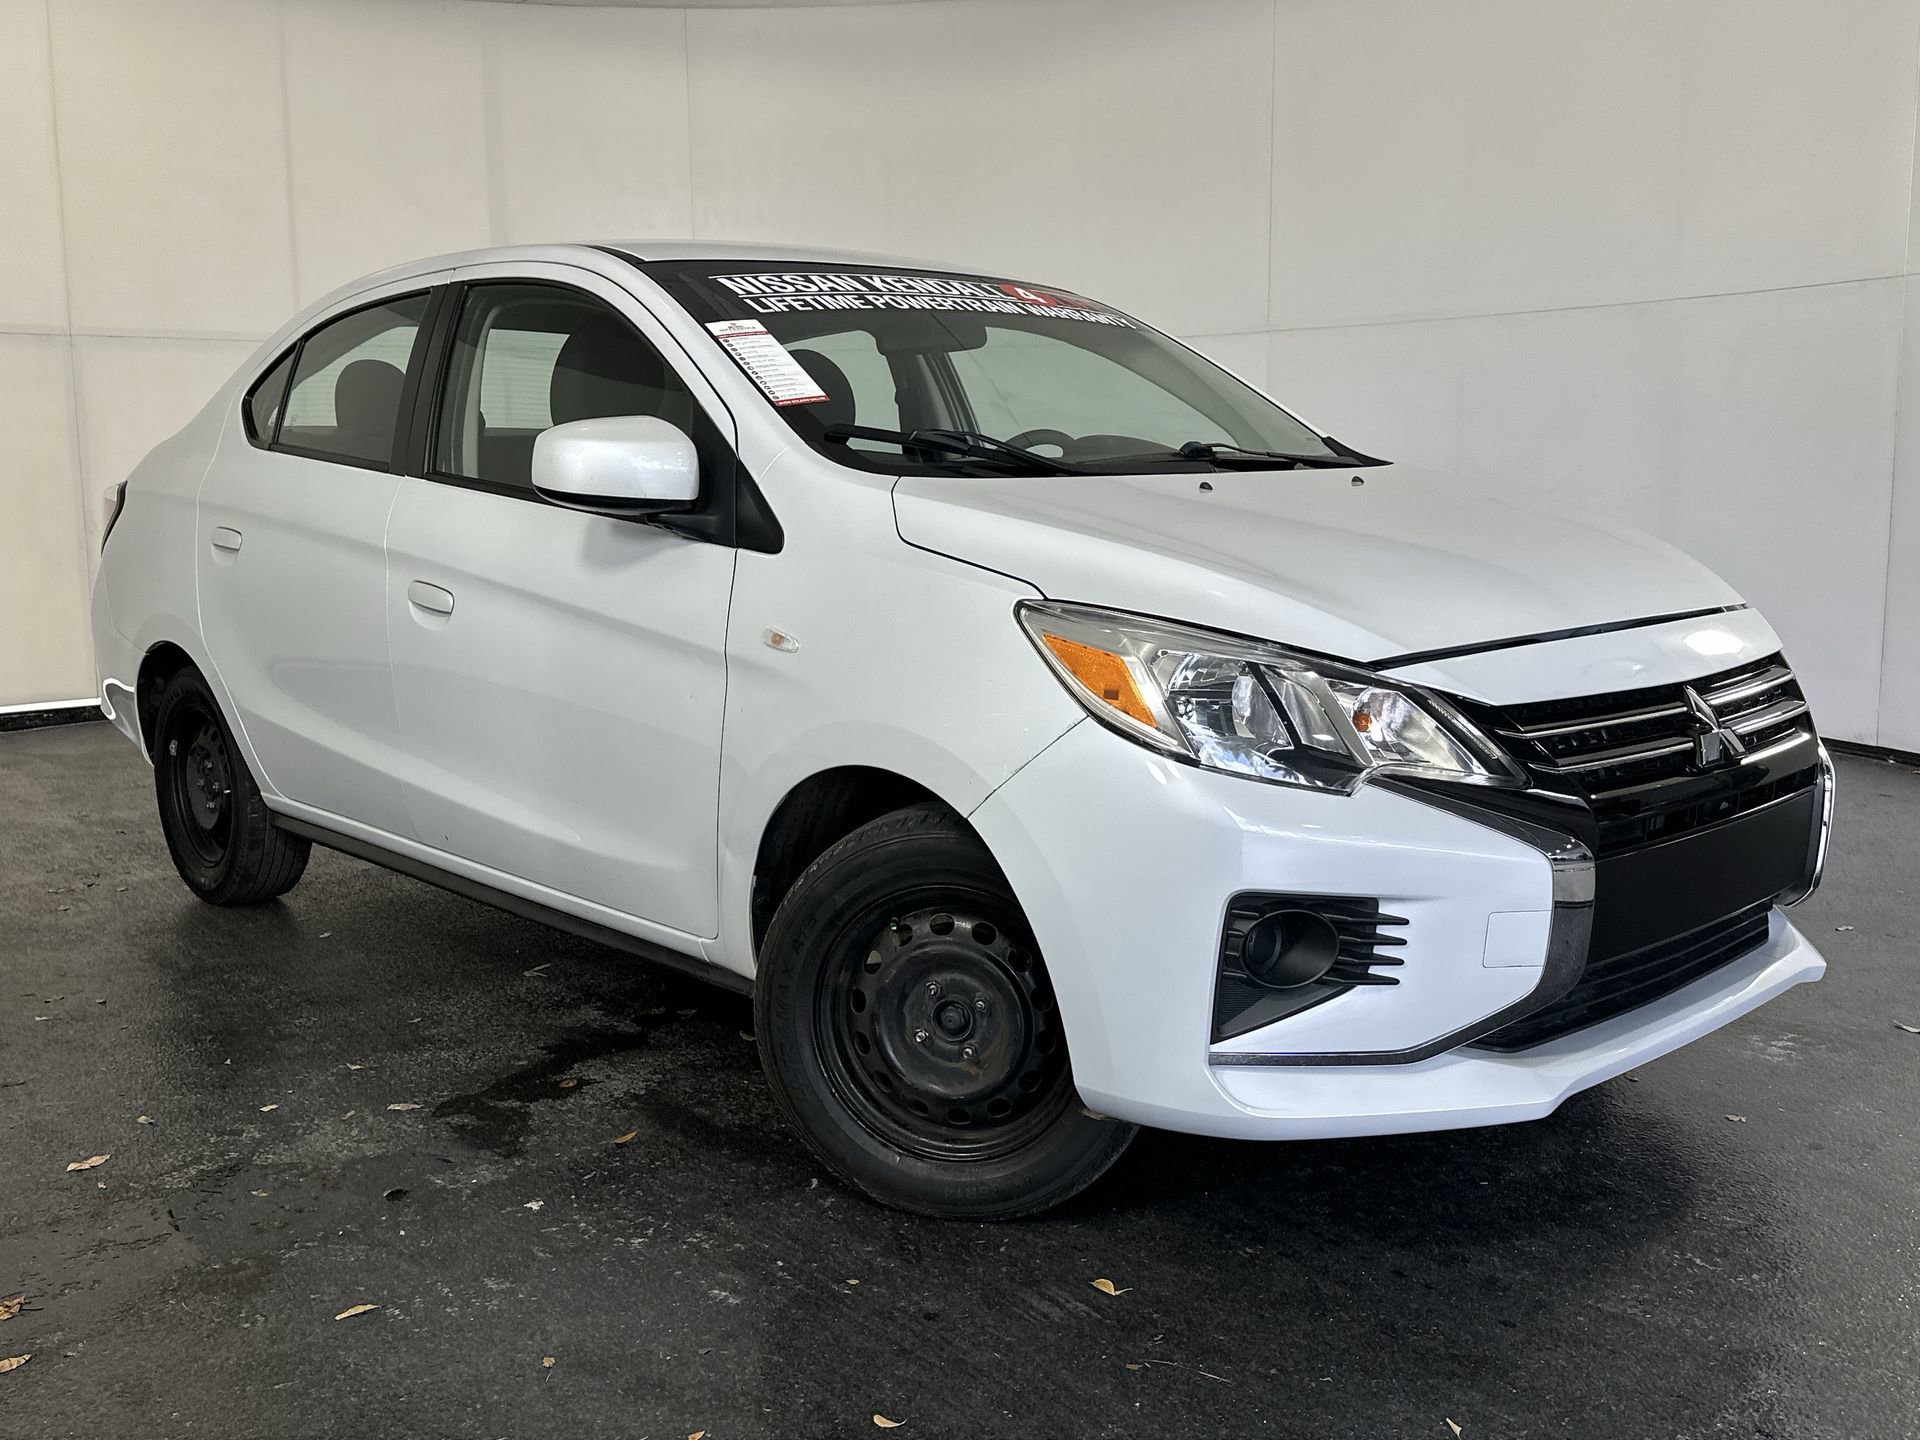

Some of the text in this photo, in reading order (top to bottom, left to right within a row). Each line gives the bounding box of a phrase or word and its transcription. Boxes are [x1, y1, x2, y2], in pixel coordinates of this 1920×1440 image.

[716, 275, 869, 295] NISSAN
[860, 276, 1017, 299] KENDALL
[743, 294, 1137, 329] LIFETIME POWERTRAIN WARRANTY
